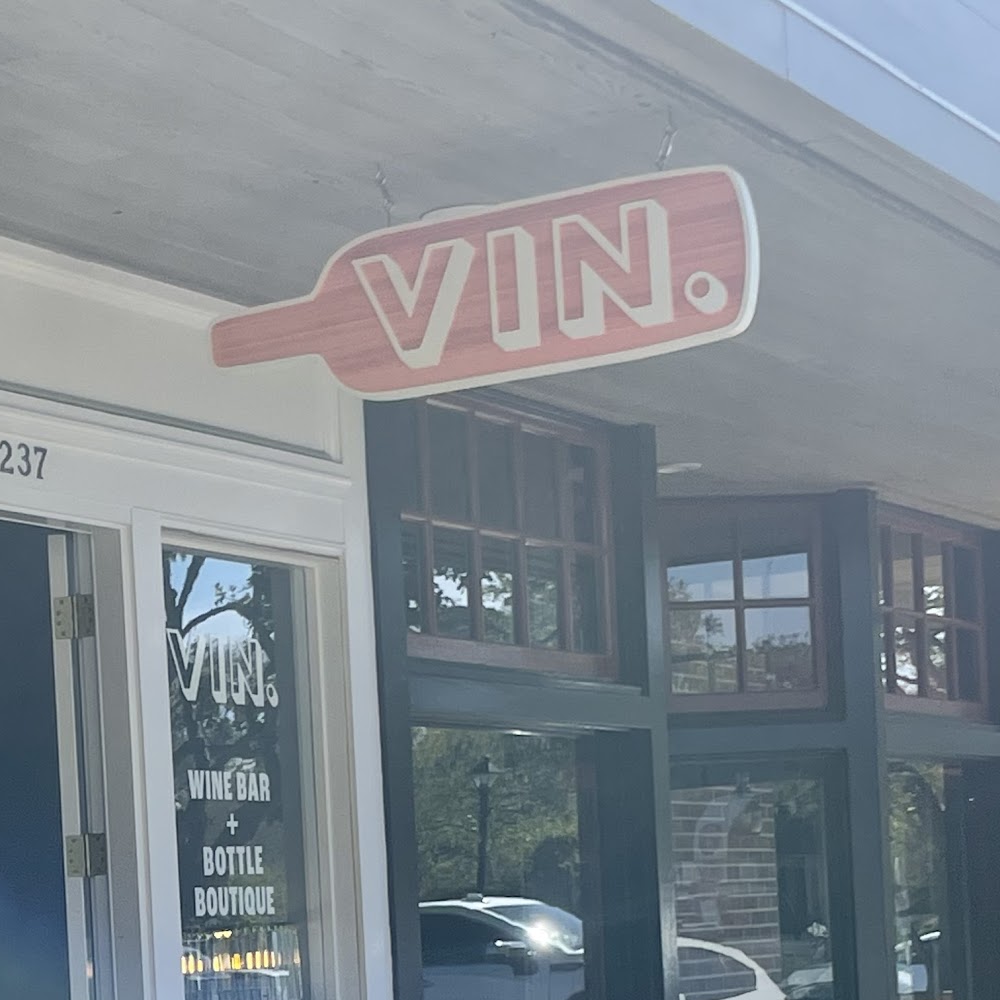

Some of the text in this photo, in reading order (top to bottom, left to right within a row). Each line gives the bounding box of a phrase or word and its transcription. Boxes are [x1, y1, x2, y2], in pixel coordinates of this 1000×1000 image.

[352, 199, 728, 369] VIN.
[0, 440, 47, 479] 237
[166, 627, 279, 708] VIN.
[187, 769, 271, 802] WINE BAR
[226, 813, 239, 835] +
[203, 846, 265, 876] BOTTLE
[194, 886, 276, 917] BOUTIQUE
